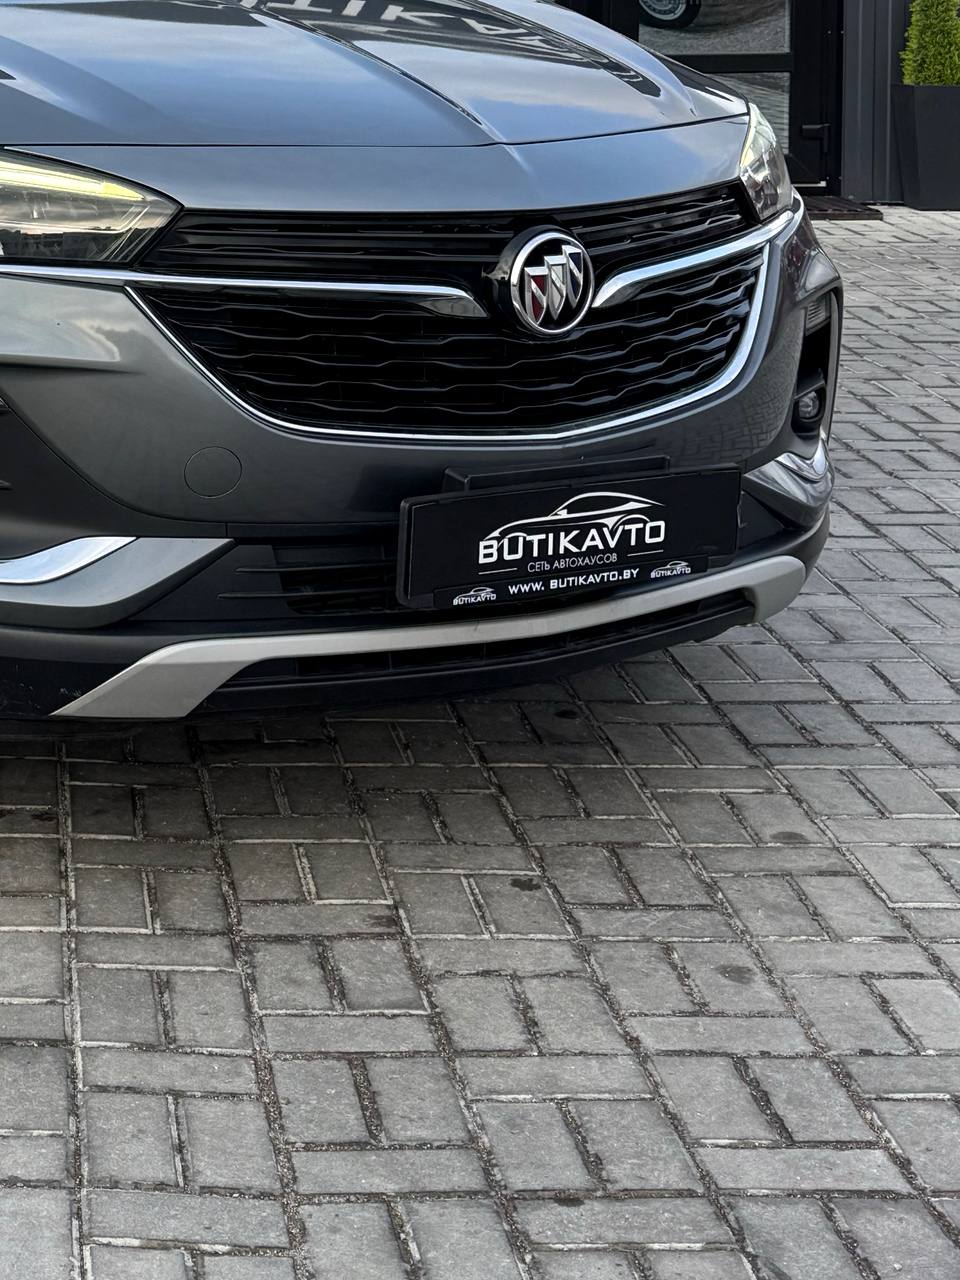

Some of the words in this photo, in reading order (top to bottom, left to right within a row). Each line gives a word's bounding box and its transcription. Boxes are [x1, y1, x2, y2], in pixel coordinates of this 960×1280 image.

[478, 520, 666, 564] BUTIKAVTO
[527, 560, 550, 573] СЕТЬ
[552, 553, 618, 571] АВТОХАУСОВ
[650, 567, 691, 579] BUTIKAVTO
[508, 580, 545, 595] WWW.
[549, 568, 640, 590] BUTIKAVTO.BY
[452, 593, 497, 606] BUTIKAVTO
